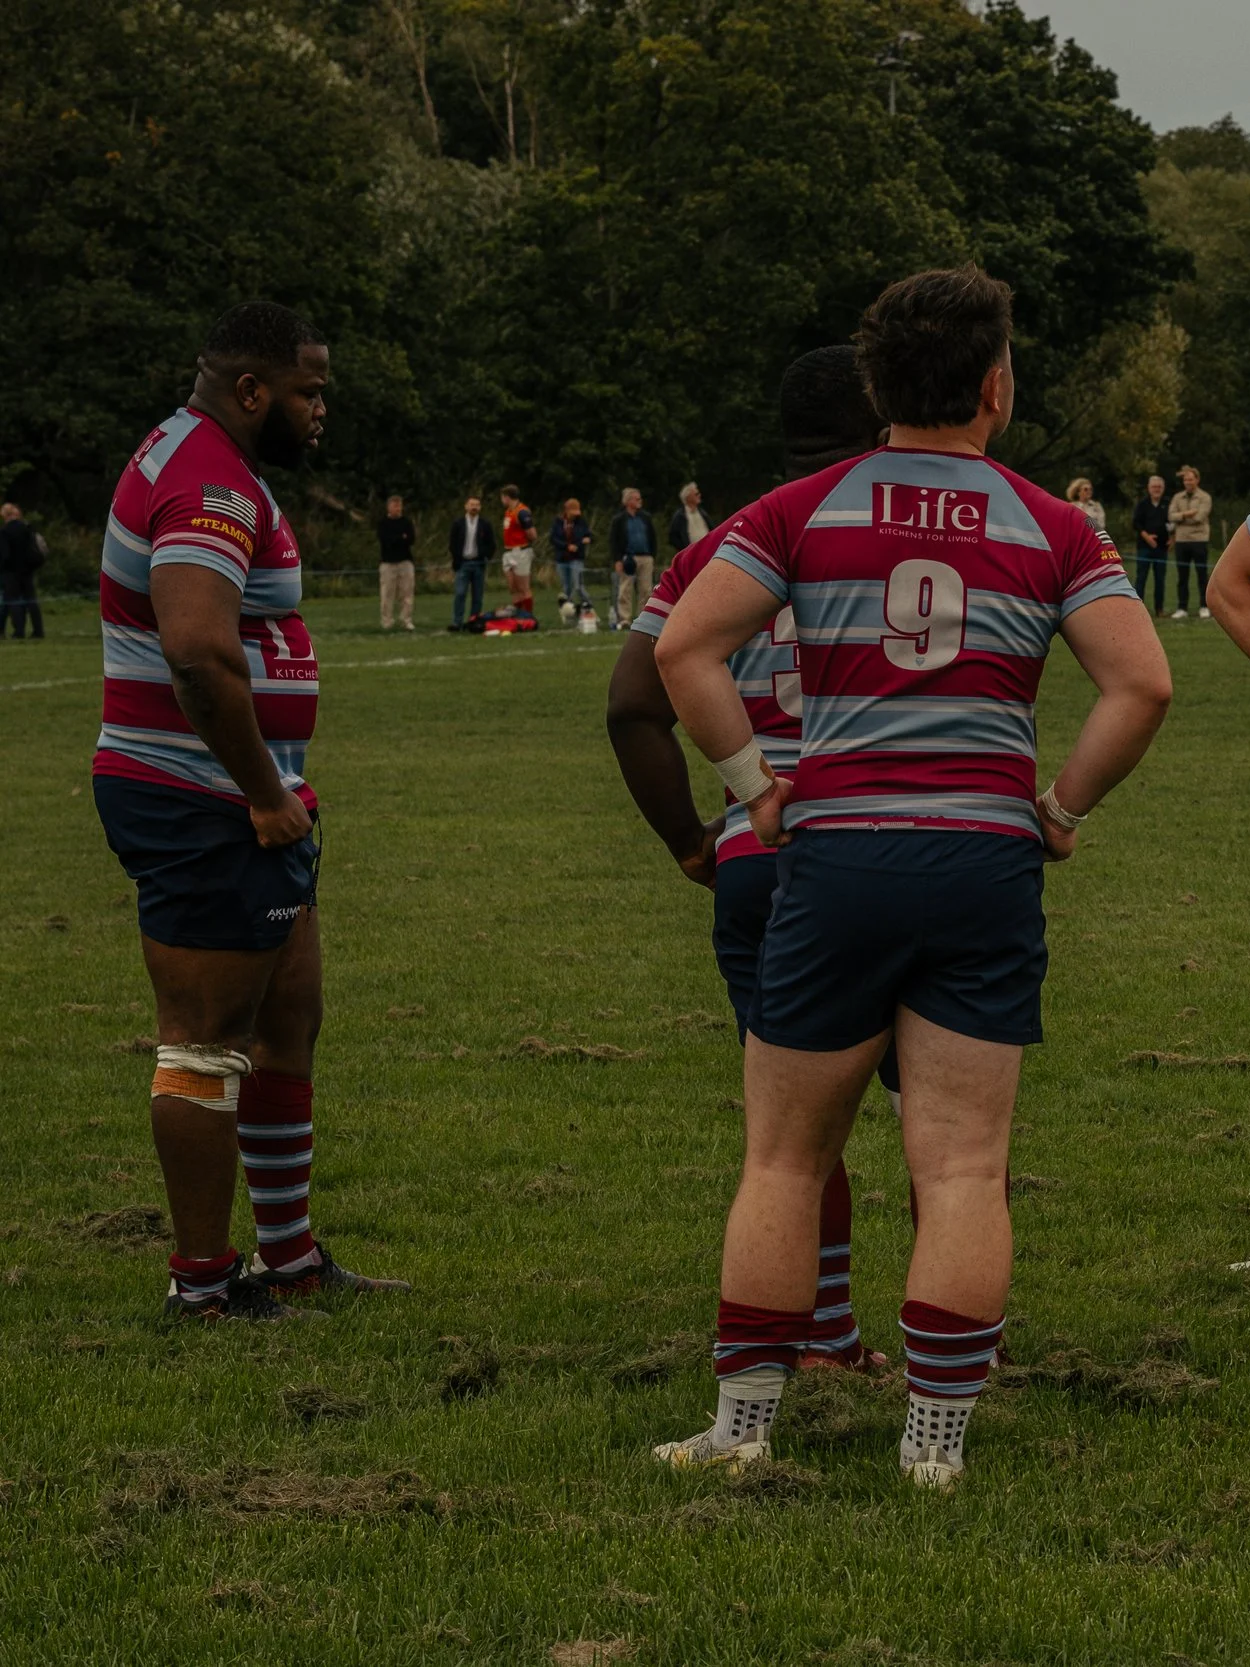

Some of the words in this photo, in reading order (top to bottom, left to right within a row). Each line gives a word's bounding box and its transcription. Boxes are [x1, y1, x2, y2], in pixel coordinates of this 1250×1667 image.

[880, 484, 980, 531] Life
[880, 528, 923, 540] KITCHENS
[926, 533, 944, 541] FOR
[948, 535, 979, 544] LIVING
[282, 549, 298, 559] AKU
[883, 558, 965, 671] 9
[275, 668, 319, 679] KITCHE
